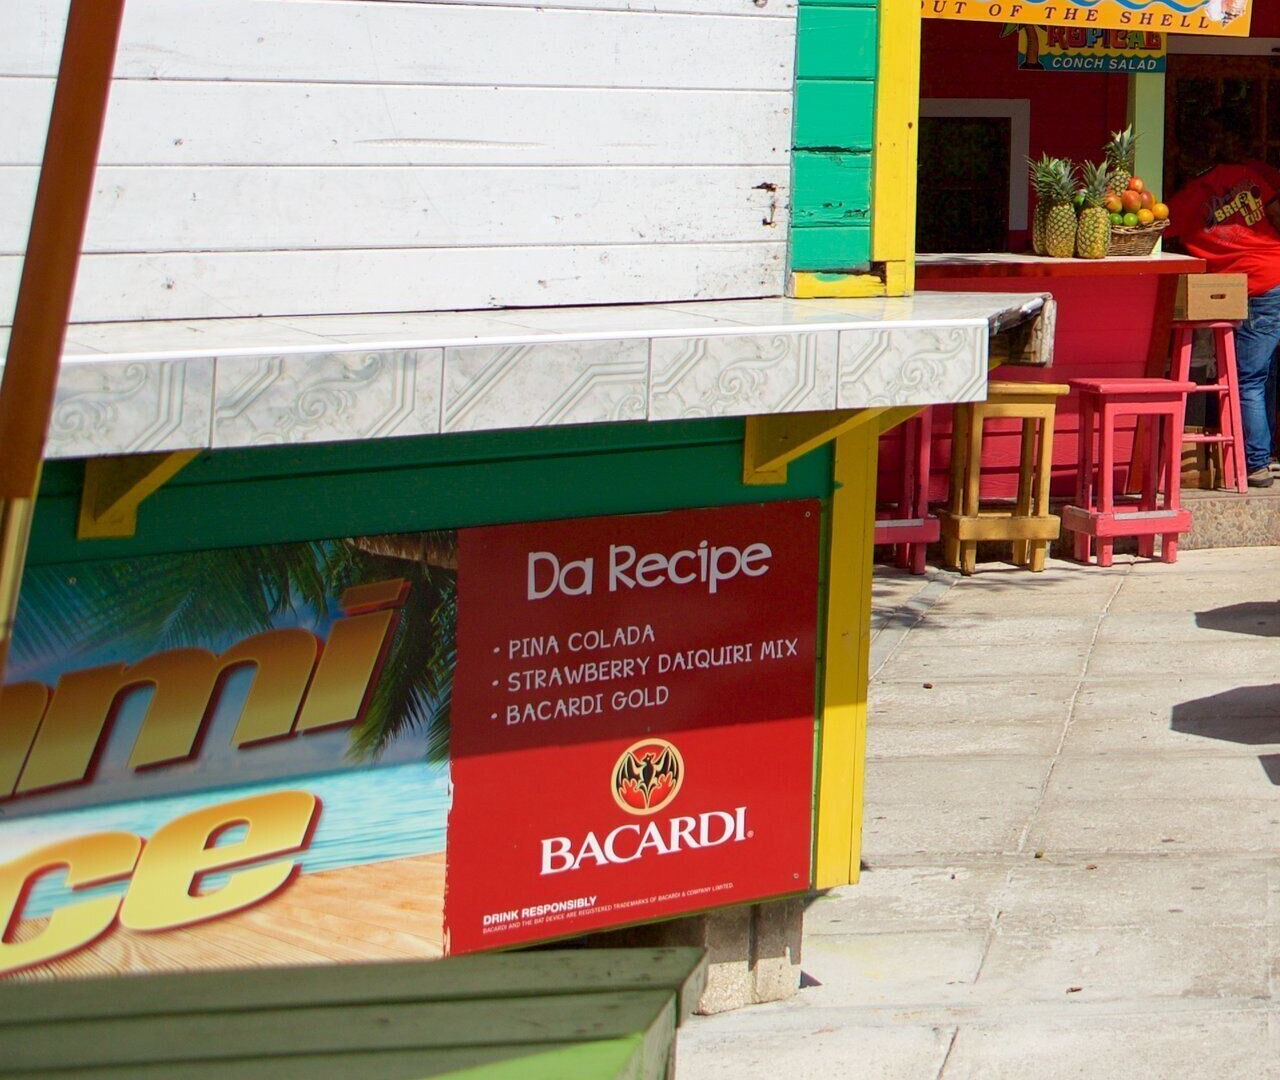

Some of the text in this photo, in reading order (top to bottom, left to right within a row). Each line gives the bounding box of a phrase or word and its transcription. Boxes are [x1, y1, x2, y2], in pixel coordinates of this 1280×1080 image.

[921, 0, 1209, 29] UT OF THE SHELL
[1052, 56, 1157, 71] CONCH SALAD
[527, 539, 773, 601] Da Recipe
[509, 624, 656, 660] PINA COLADA
[507, 638, 799, 692] STRAWBERRY DAIQUIRI MIX
[506, 685, 670, 725] BACARDI GOLD
[539, 806, 747, 876] BACARDI
[483, 923, 508, 934] BACARDI
[508, 920, 521, 930] AND
[521, 918, 533, 927] THE
[545, 912, 565, 923] DEVICE
[566, 910, 577, 919] ARE
[578, 905, 613, 917] REGISTERED
[613, 898, 649, 911] TRADEMARKS
[650, 896, 657, 904] OF
[658, 891, 681, 902] BACARDI
[686, 886, 712, 897] COMPANY
[483, 895, 597, 926] DRINK RESPONSIBLY
